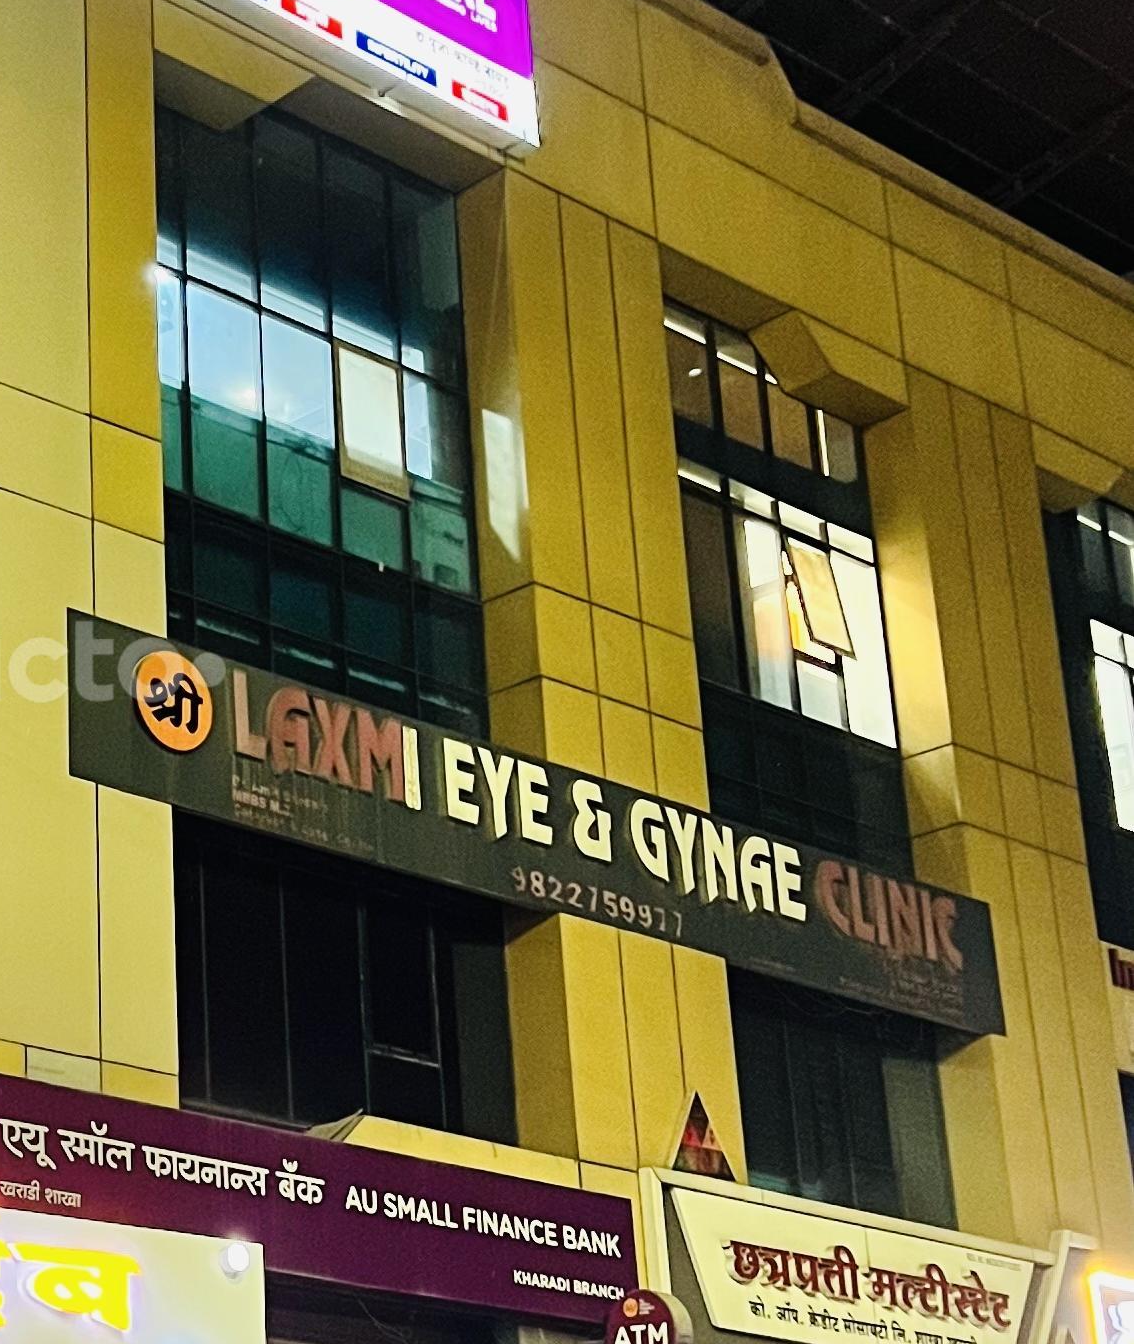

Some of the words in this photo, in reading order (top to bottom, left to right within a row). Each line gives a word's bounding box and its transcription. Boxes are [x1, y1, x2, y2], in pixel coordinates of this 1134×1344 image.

[233, 668, 422, 811] LAXMI
[442, 736, 554, 846] EYE
[572, 778, 613, 863] &
[629, 798, 808, 923] GYNAE
[816, 859, 963, 967] CLINIC
[511, 866, 684, 939] 9822759977
[0, 1179, 41, 1204] खराडी
[45, 1184, 83, 1209] शाखा
[60, 1122, 136, 1172] स्मॉल
[144, 1145, 270, 1197] फायनान्स
[275, 1159, 326, 1206] बँक
[346, 1185, 378, 1215] AU
[384, 1193, 459, 1231] SMALL
[463, 1206, 559, 1248] FINANCE
[563, 1224, 623, 1258] BANK
[513, 1268, 571, 1293] KHARADI
[573, 1279, 625, 1301] BRANCH
[728, 1240, 861, 1302] छत्रपती
[867, 1263, 1012, 1329] मल्टीस्टेट
